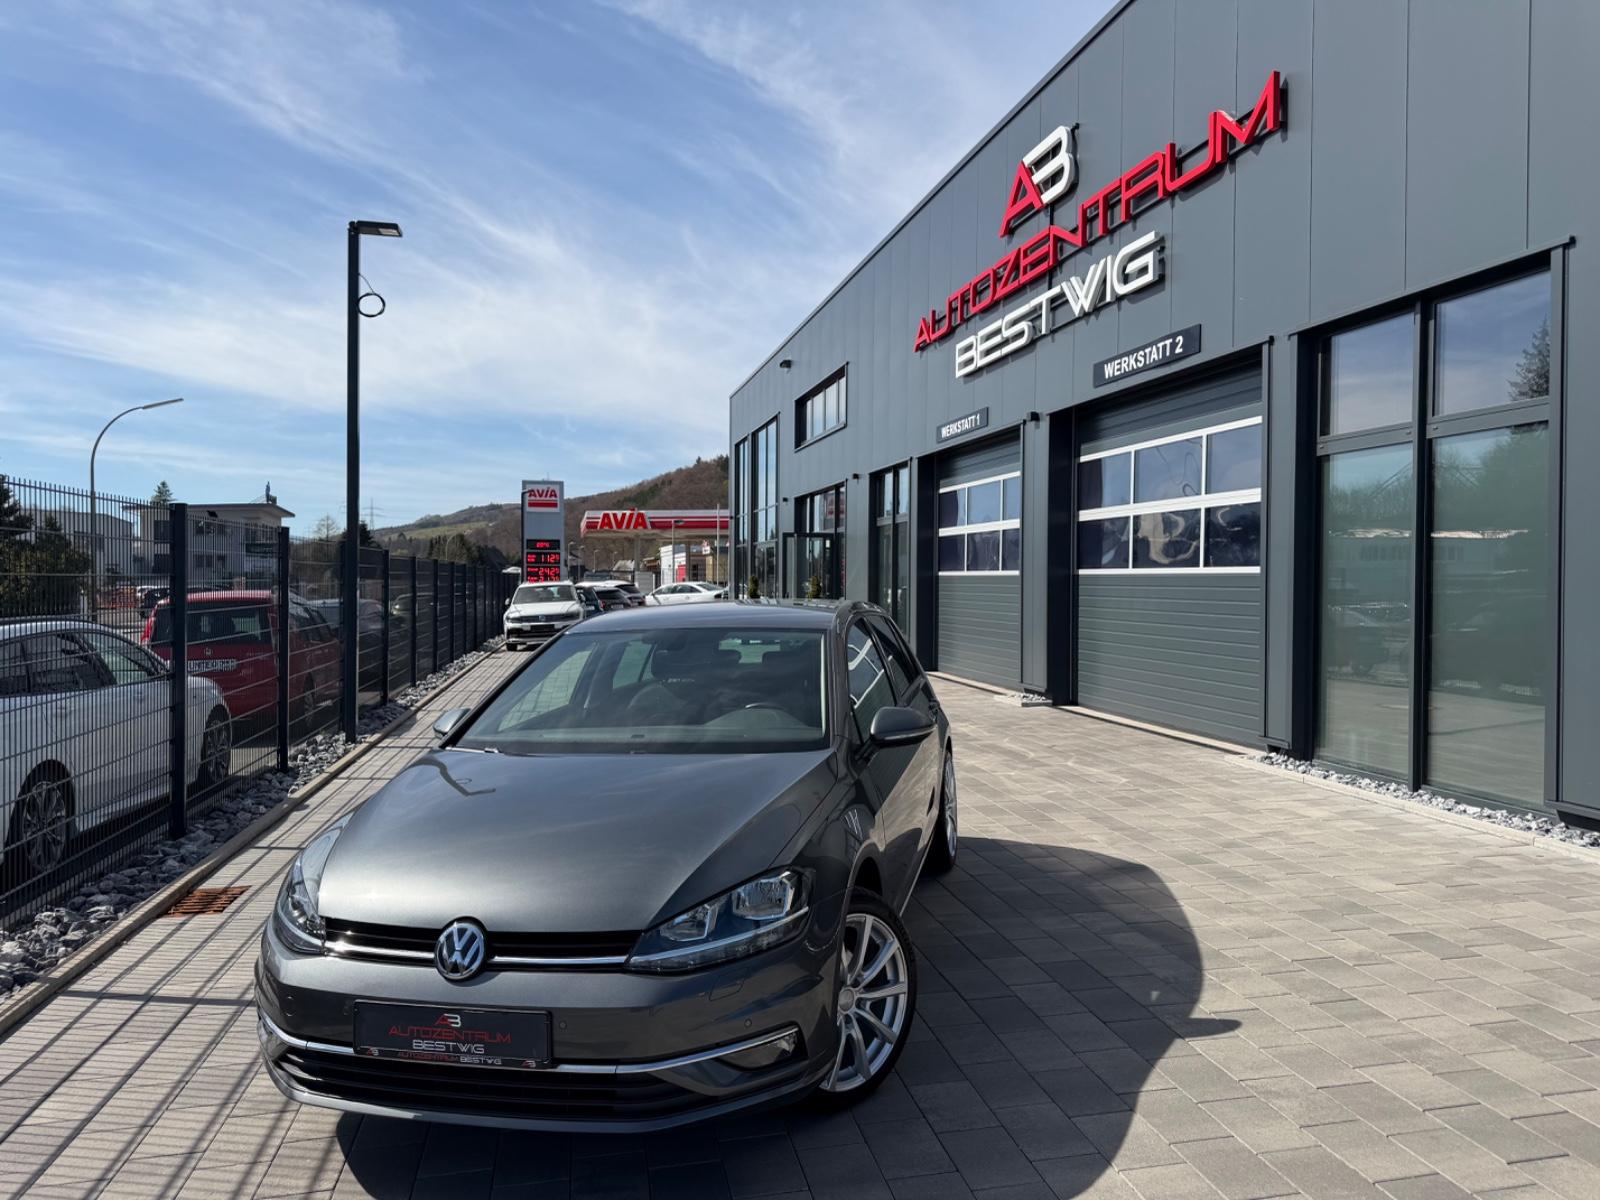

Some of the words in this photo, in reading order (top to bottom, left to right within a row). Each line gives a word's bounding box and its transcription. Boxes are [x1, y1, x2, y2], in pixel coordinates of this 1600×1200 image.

[913, 70, 1281, 352] AUTOZENTRUM
[955, 231, 1159, 378] BESTWIG
[1104, 339, 1173, 379] WERKSTATT
[1174, 335, 1184, 354] 2
[941, 415, 976, 439] WERKSTATT
[528, 486, 557, 498] AVIA
[600, 507, 648, 529] AVIA
[388, 1026, 512, 1043] AUTOZENTRUM
[412, 1039, 485, 1054] BESTWIG
[460, 1055, 502, 1065] BESTWIG
